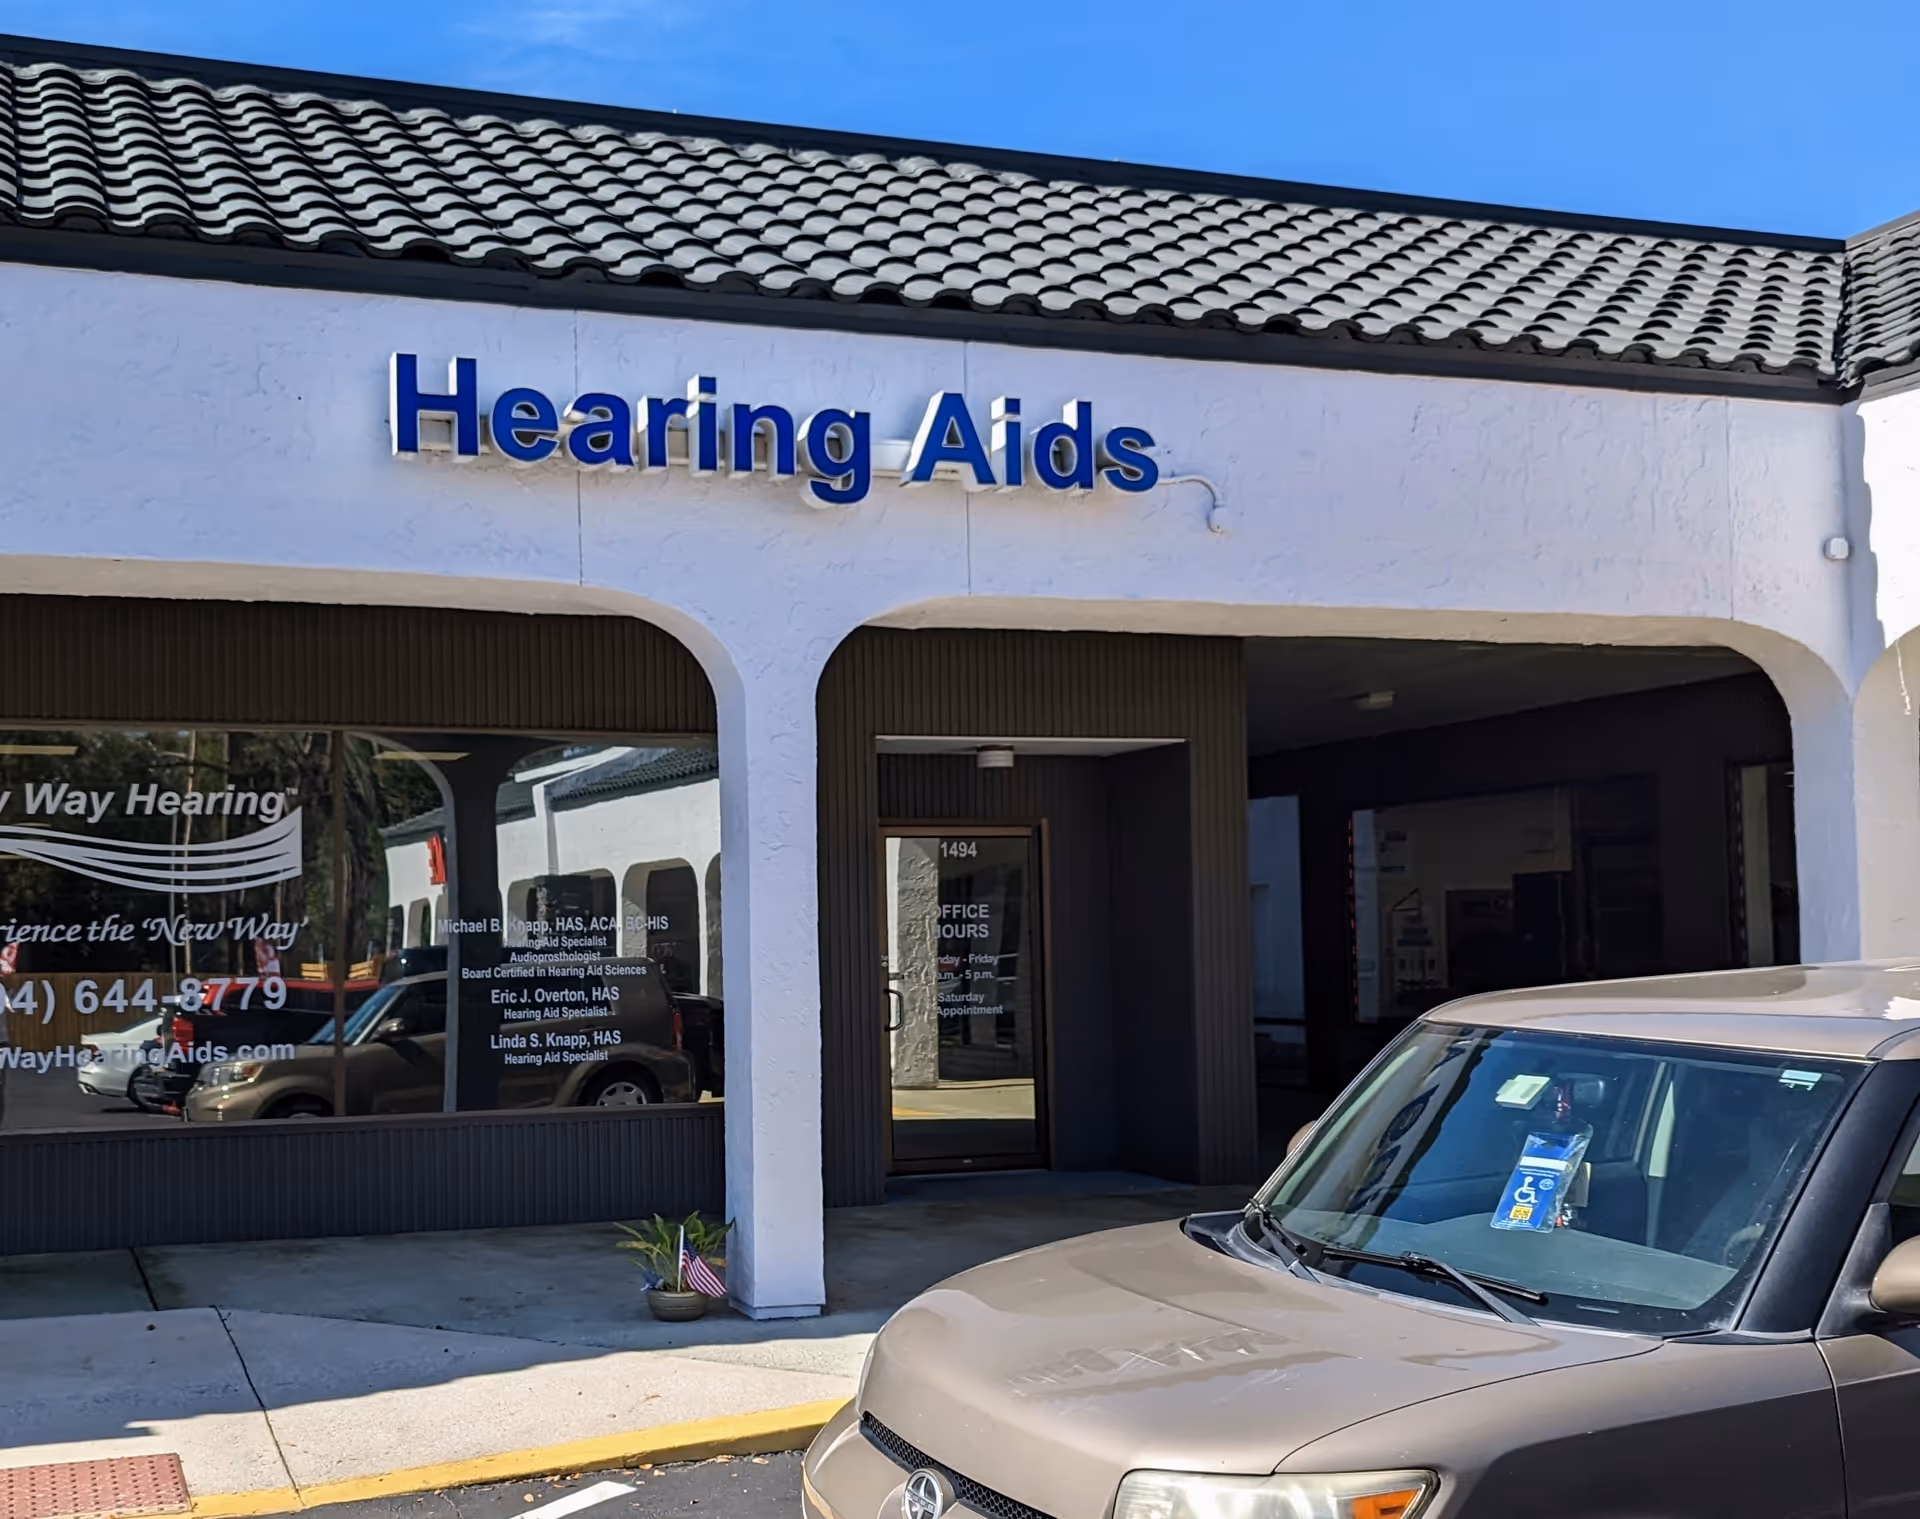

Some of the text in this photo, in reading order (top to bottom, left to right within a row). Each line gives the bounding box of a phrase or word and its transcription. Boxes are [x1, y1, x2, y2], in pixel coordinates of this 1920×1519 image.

[390, 352, 1160, 505] Hearing Aids
[25, 782, 115, 823] Way
[126, 782, 286, 824] Hearing
[940, 841, 977, 858] 1494
[87, 913, 135, 942] the
[436, 918, 488, 933] Michael
[490, 917, 504, 933] B.
[508, 916, 552, 935] Knapp,
[555, 916, 587, 933] HAS,
[543, 936, 559, 948] Aid
[561, 935, 608, 950] Specialist
[510, 950, 602, 964] Audioprosthologist
[968, 953, 999, 966] Friday
[461, 963, 647, 979] Board Certified in Hearing Aid Sciences
[965, 969, 972, 980] 5
[0, 976, 288, 1025] 4) 644-8779
[491, 985, 620, 1004] Eric J. Overton, HAS
[937, 992, 985, 1004] Saturday
[504, 1006, 608, 1021] Hearing Aid Specialist
[937, 1004, 1004, 1018] Appointment
[490, 1030, 622, 1050] Linda S. Knapp, HAS
[504, 1050, 609, 1066] Hearing Aid Specialist
